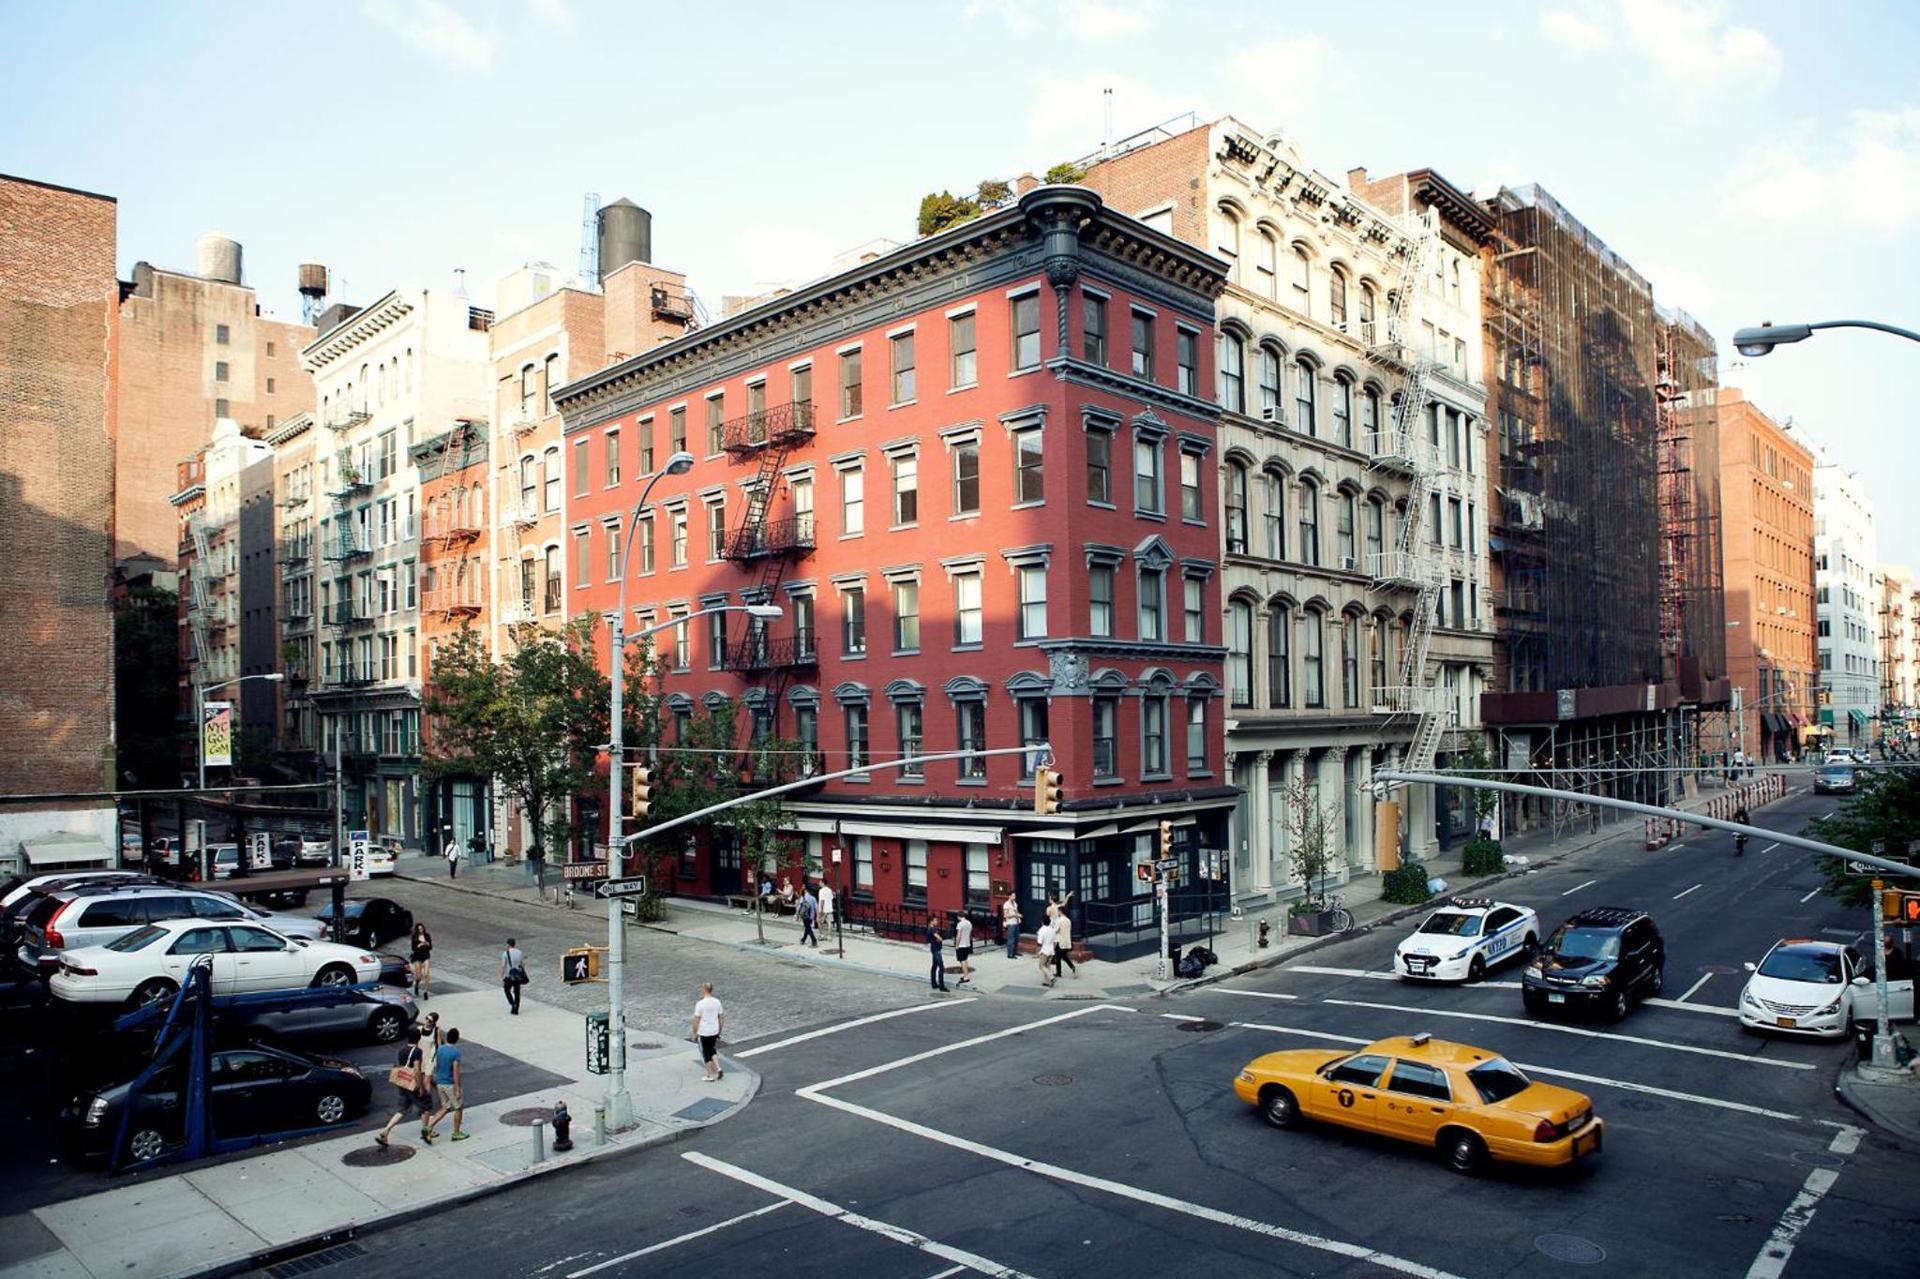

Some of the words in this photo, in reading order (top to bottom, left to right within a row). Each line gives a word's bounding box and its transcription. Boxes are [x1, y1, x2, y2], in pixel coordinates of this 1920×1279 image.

[207, 721, 228, 735] NYC
[256, 832, 266, 859] PARK
[354, 841, 365, 870] PARK
[563, 866, 594, 879] BROOME
[597, 864, 607, 876] ST
[602, 884, 617, 894] ONE
[623, 881, 639, 890] WAY
[1340, 1090, 1352, 1106] T
